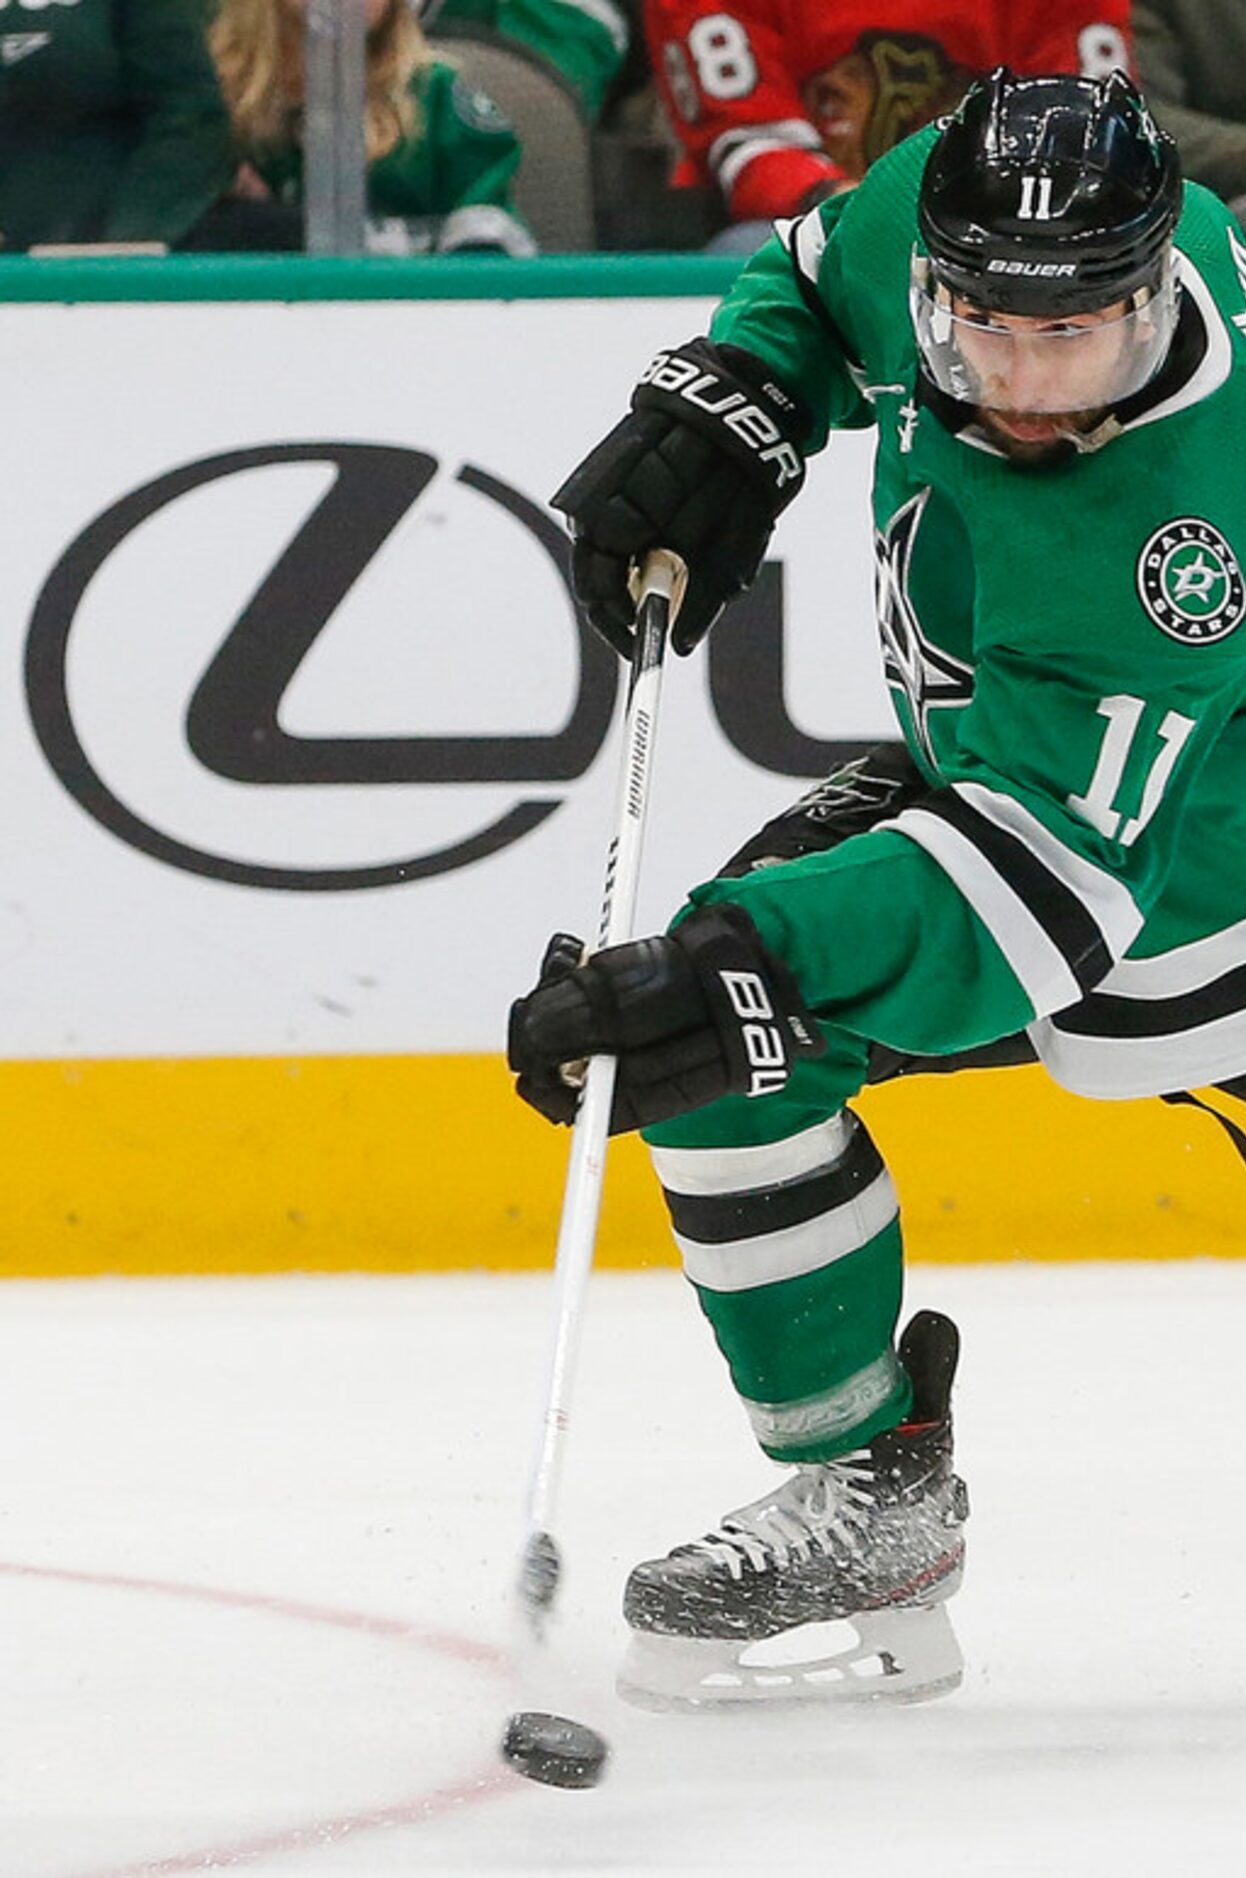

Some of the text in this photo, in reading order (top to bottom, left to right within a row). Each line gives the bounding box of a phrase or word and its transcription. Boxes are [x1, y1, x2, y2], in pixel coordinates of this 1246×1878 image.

[1017, 177, 1052, 219] 11
[987, 259, 1076, 277] BAUER
[1147, 526, 1238, 575] DALLAS
[1152, 597, 1239, 636] STARS
[1066, 694, 1197, 847] 11
